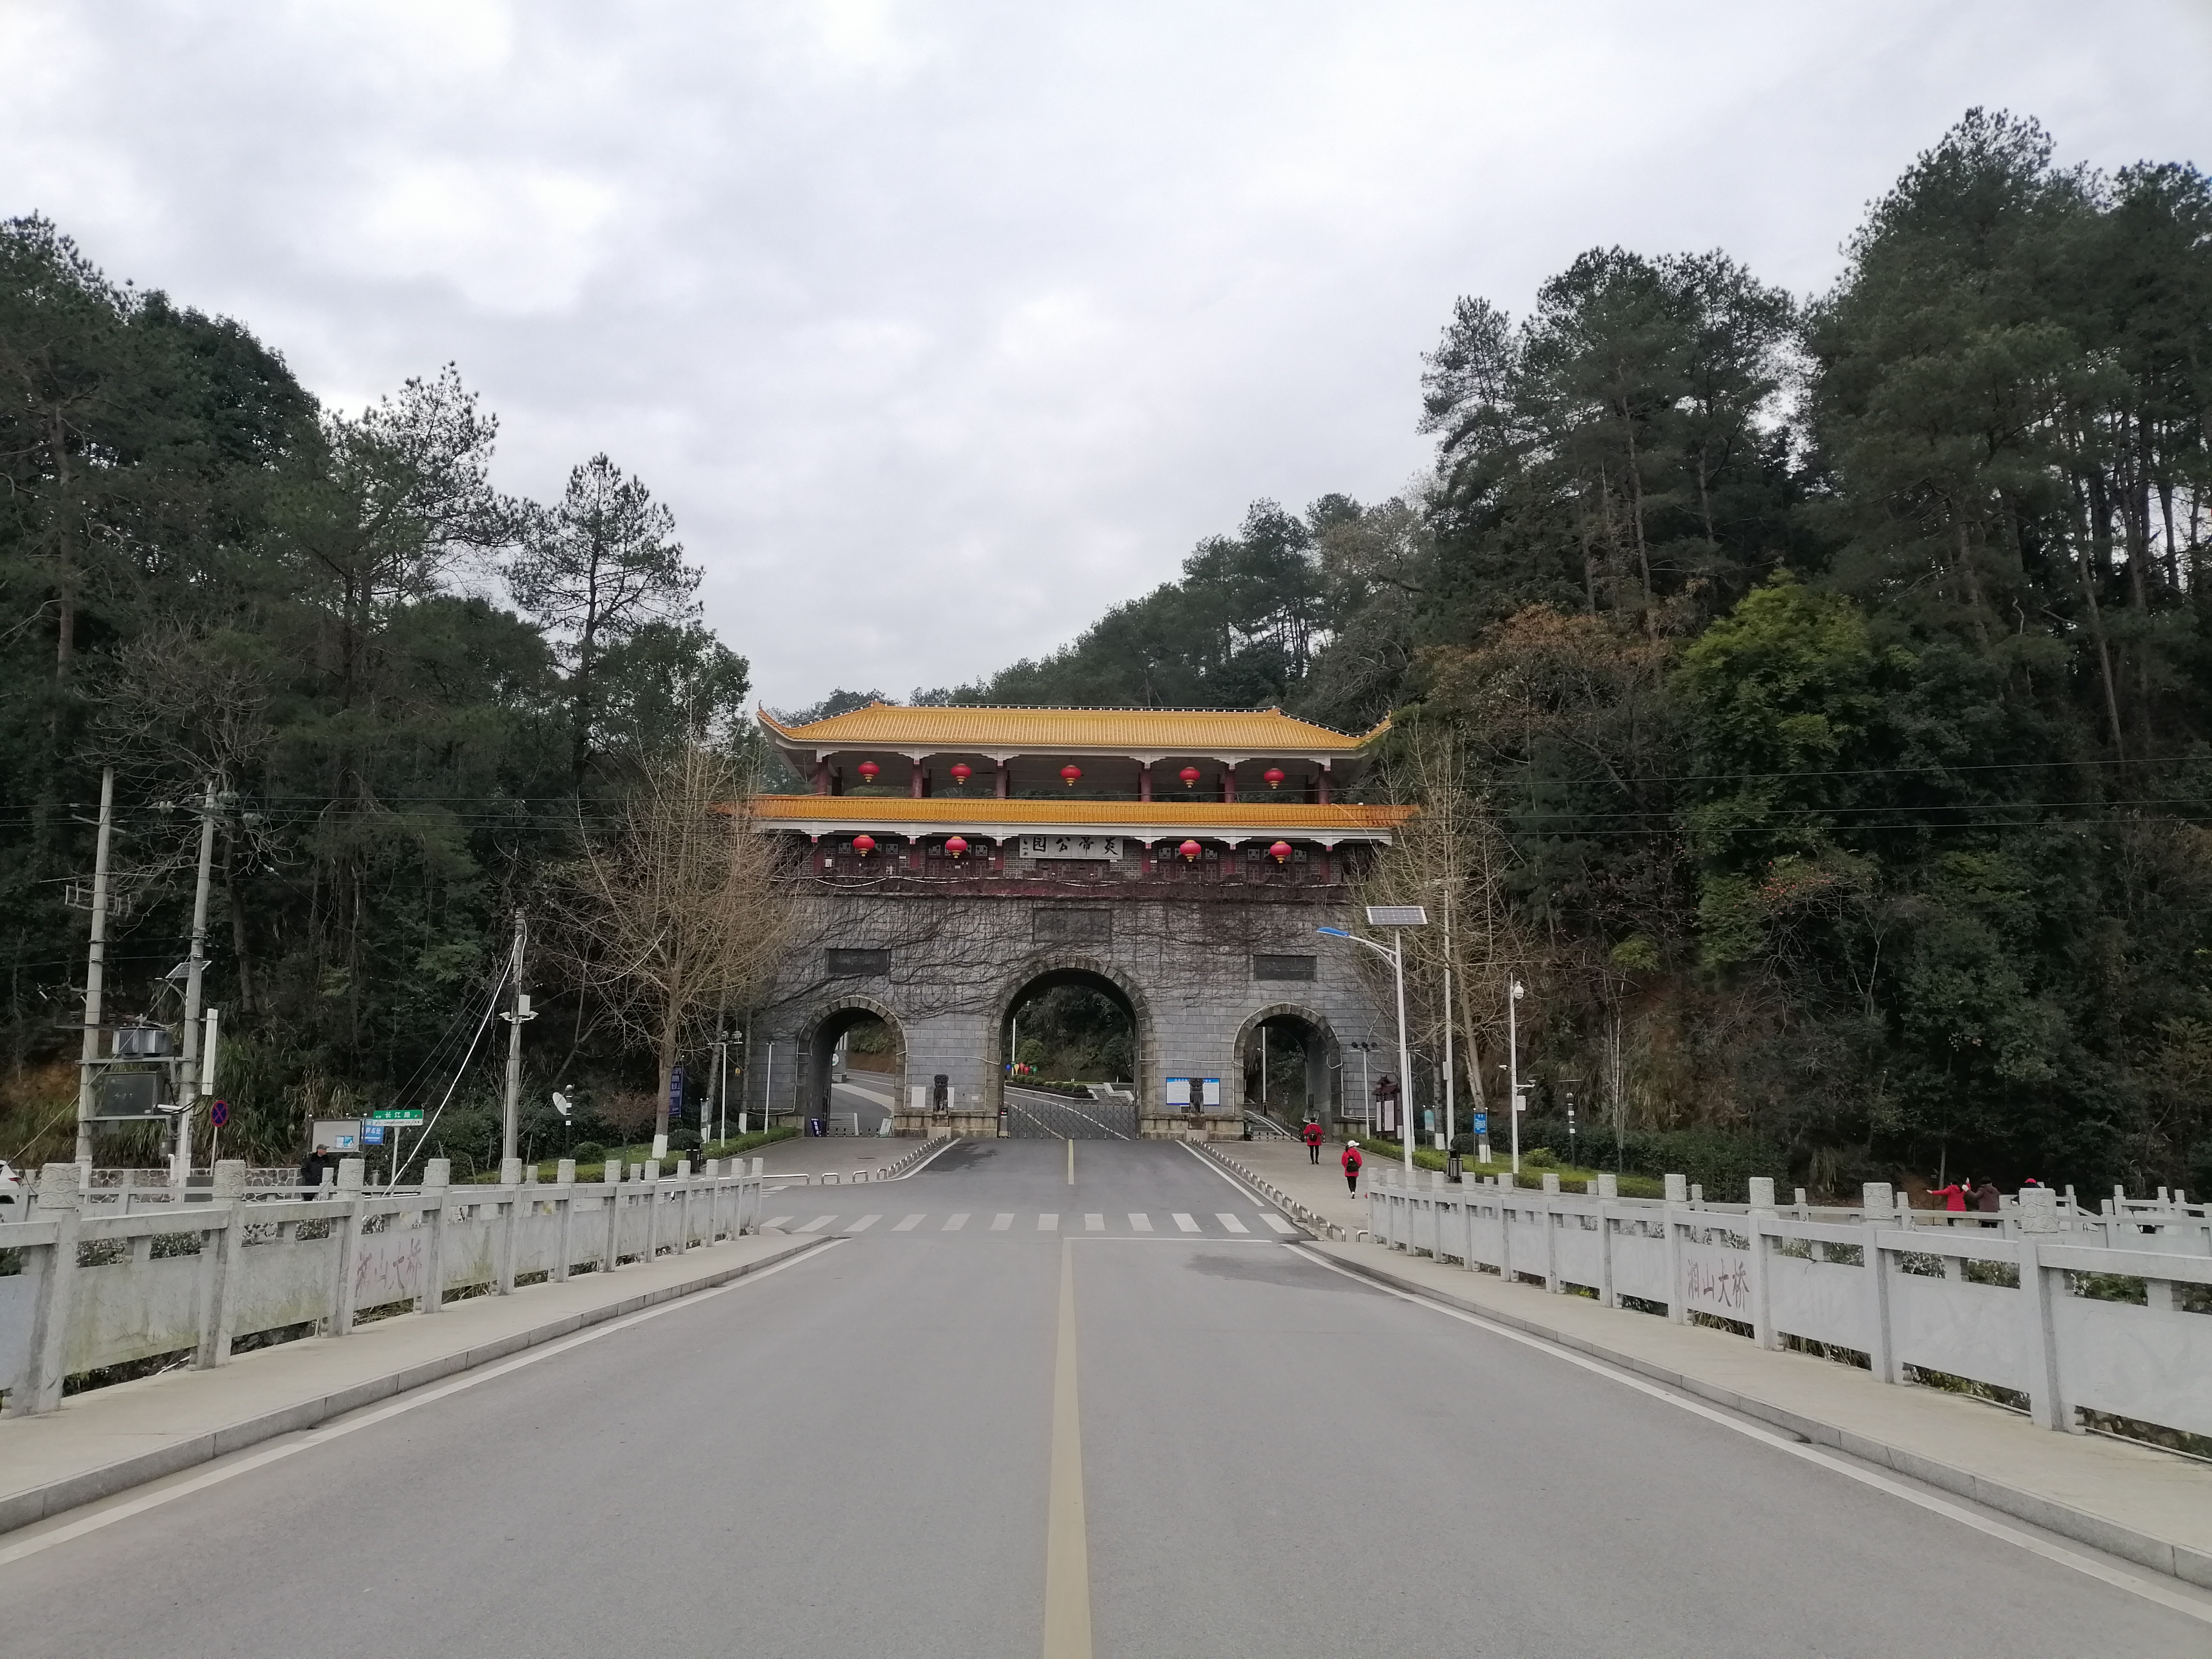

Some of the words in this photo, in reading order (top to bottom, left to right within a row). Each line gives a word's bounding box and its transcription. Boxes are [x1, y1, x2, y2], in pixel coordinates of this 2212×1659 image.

[1033, 836, 1118, 856] 炎帝公园
[1687, 1257, 1750, 1313] 湘山大桥
